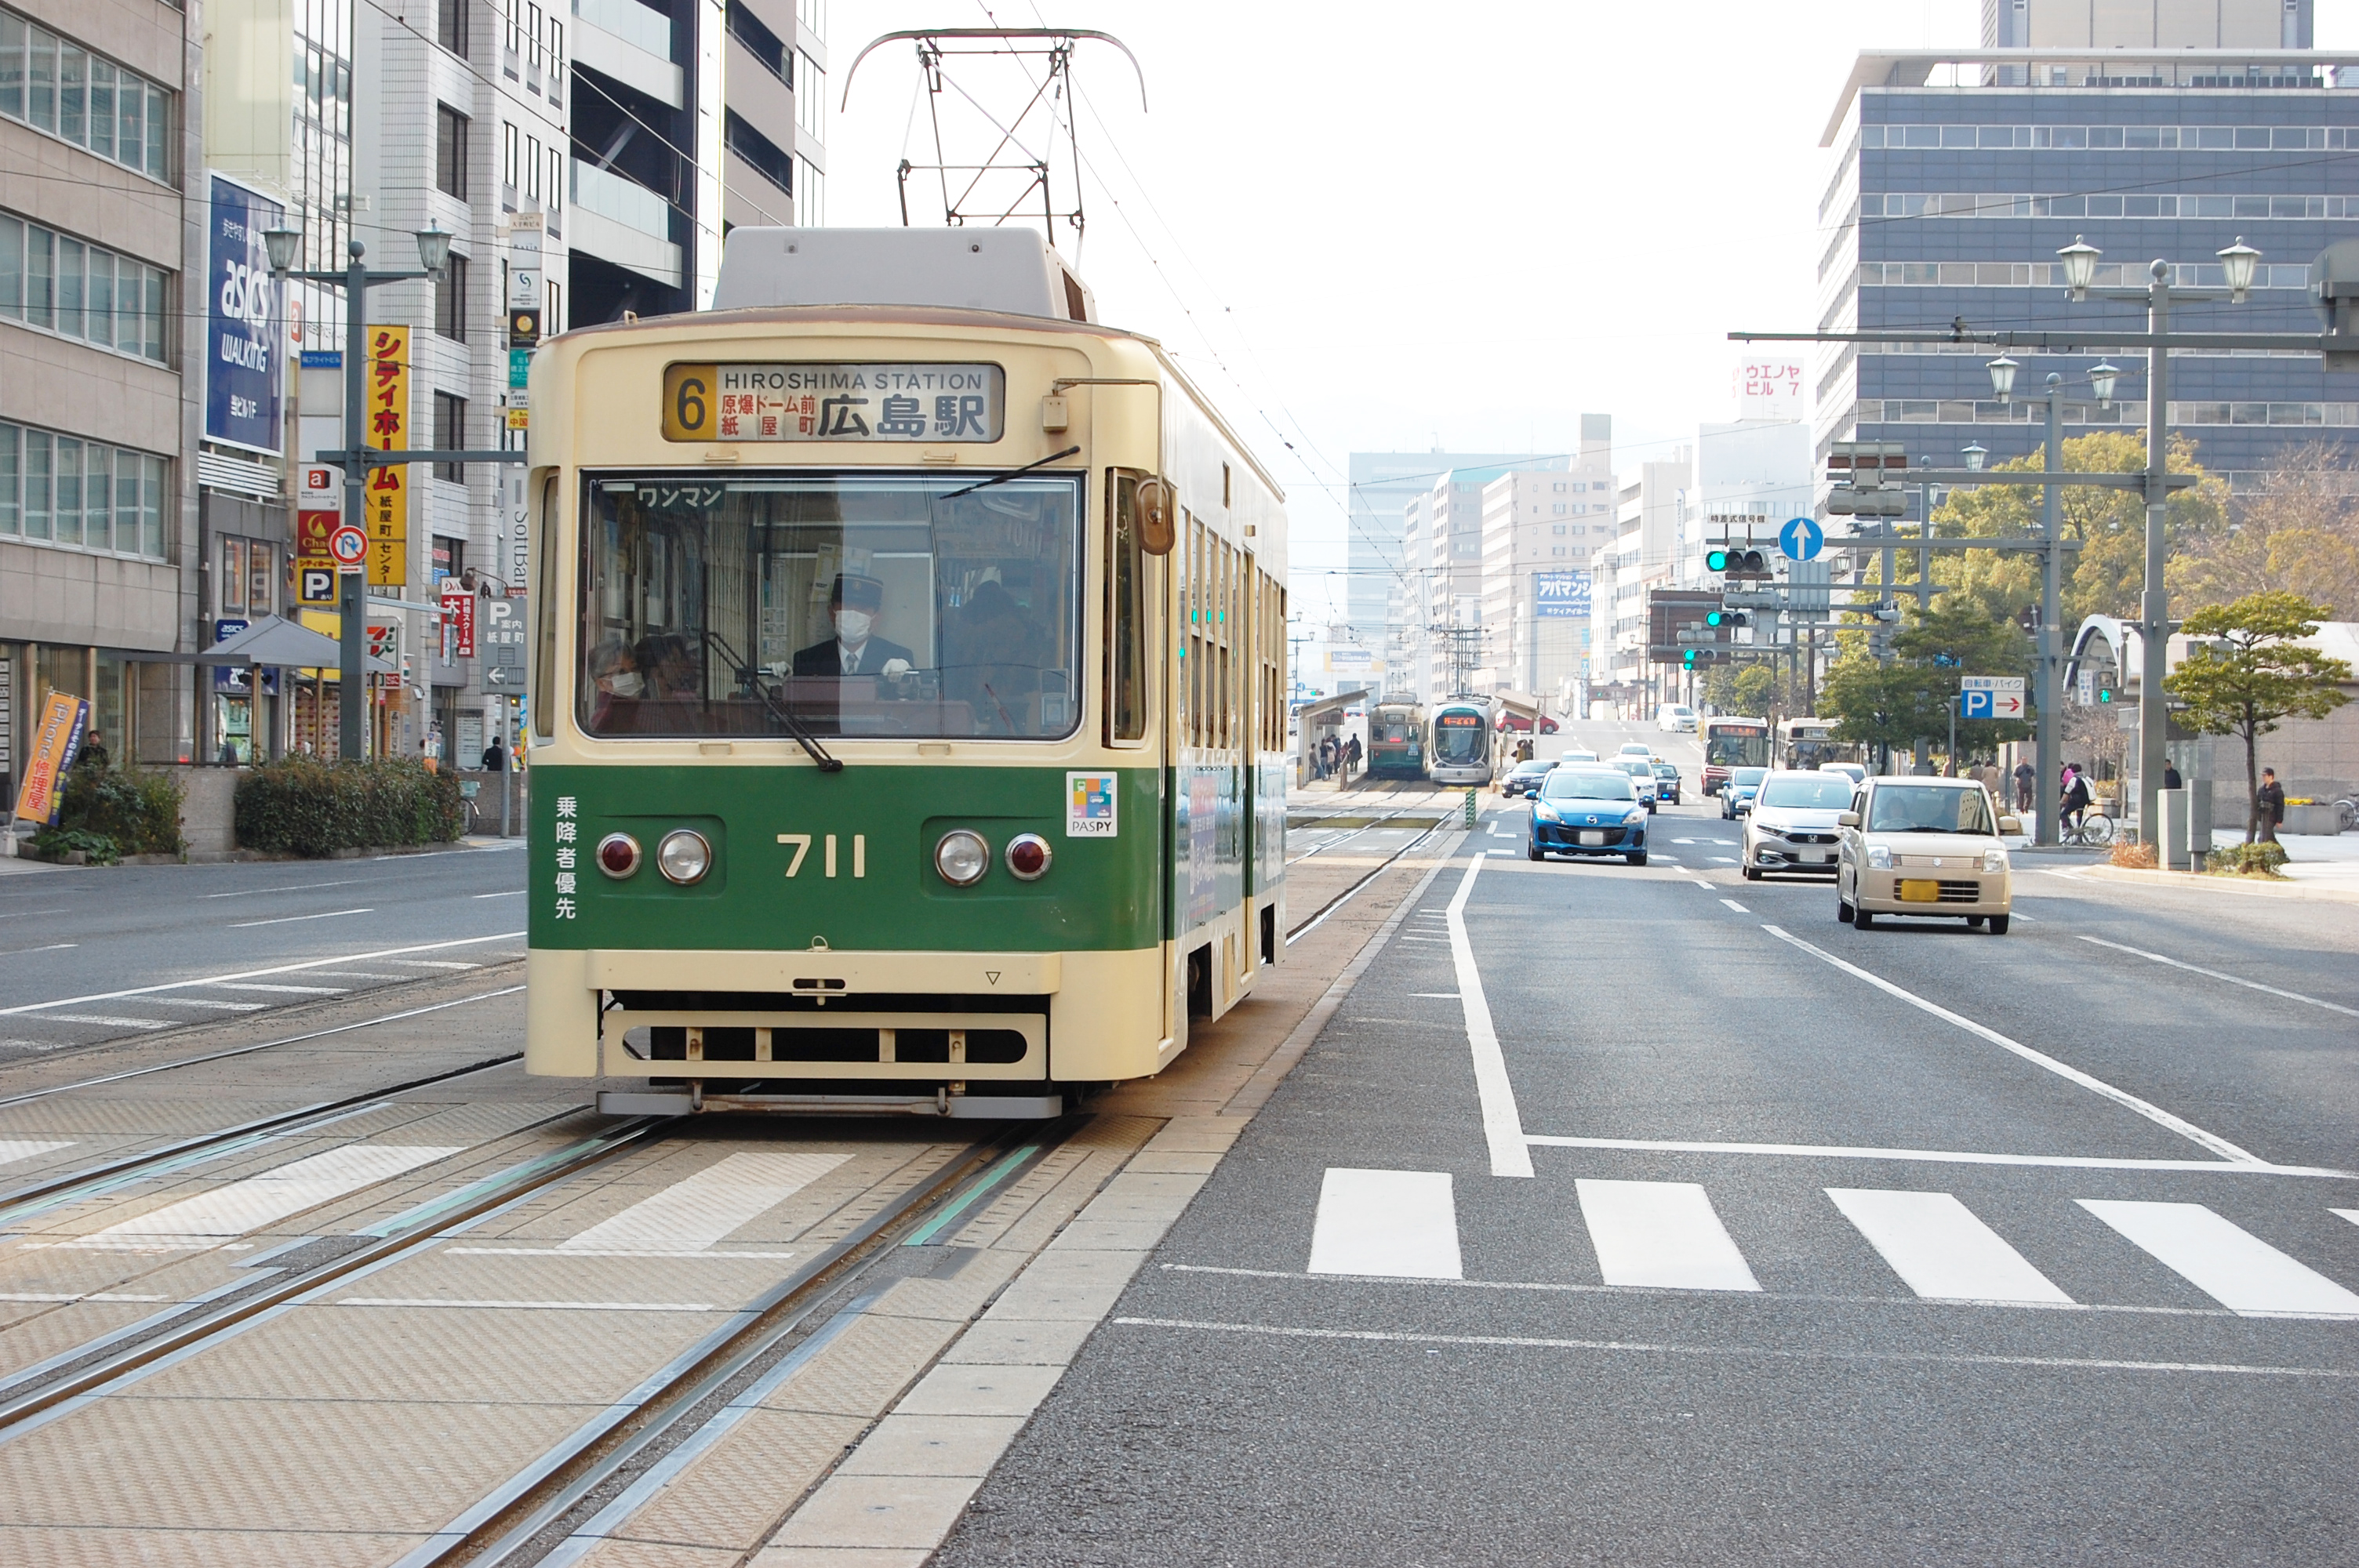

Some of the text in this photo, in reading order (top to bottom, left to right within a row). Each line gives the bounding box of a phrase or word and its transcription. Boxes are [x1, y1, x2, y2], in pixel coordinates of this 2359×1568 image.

[221, 260, 268, 328] asics
[221, 332, 268, 373] WALKING
[1747, 365, 1800, 379] ウエノヤ
[677, 372, 982, 430] 6 HIROSHIMA STATION
[1747, 381, 1773, 395] ビル
[1789, 382, 1799, 396] 7
[722, 394, 816, 415] 原爆ドーム前
[818, 394, 985, 437] 広島駅
[638, 487, 722, 508] ワンマン
[379, 495, 392, 537] 紙屋町
[380, 543, 392, 583] センター
[306, 573, 330, 598] P
[490, 602, 512, 625] P
[501, 619, 522, 630] 案内
[487, 631, 525, 644] 紙屋町
[1967, 691, 1987, 716] P
[1072, 821, 1112, 832] PASPY
[555, 796, 577, 920] 乗降者優先
[776, 833, 865, 878] 711
